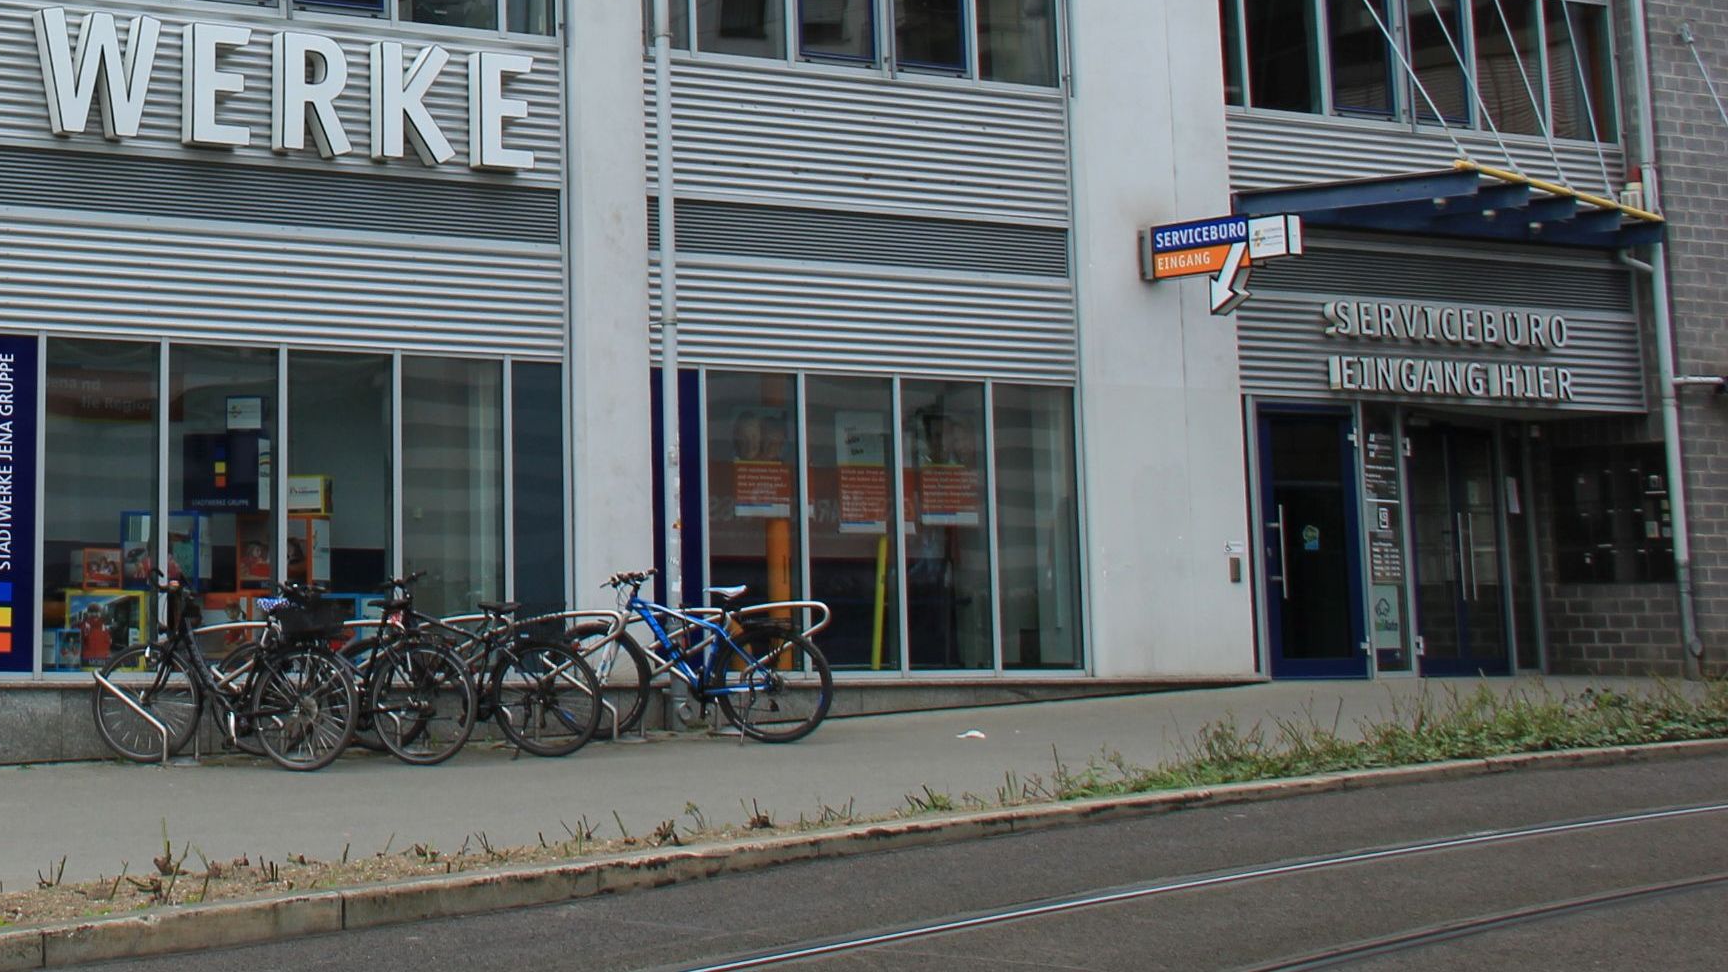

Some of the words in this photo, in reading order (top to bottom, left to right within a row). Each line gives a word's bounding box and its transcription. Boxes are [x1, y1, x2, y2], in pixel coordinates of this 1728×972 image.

[32, 6, 536, 170] WERKE
[1157, 251, 1211, 271] EINGANG
[1324, 300, 1568, 349] SERVICEBÜRO
[0, 352, 15, 417] GRUPPE
[1329, 355, 1484, 396] EINGANG
[1488, 363, 1574, 402] HIER
